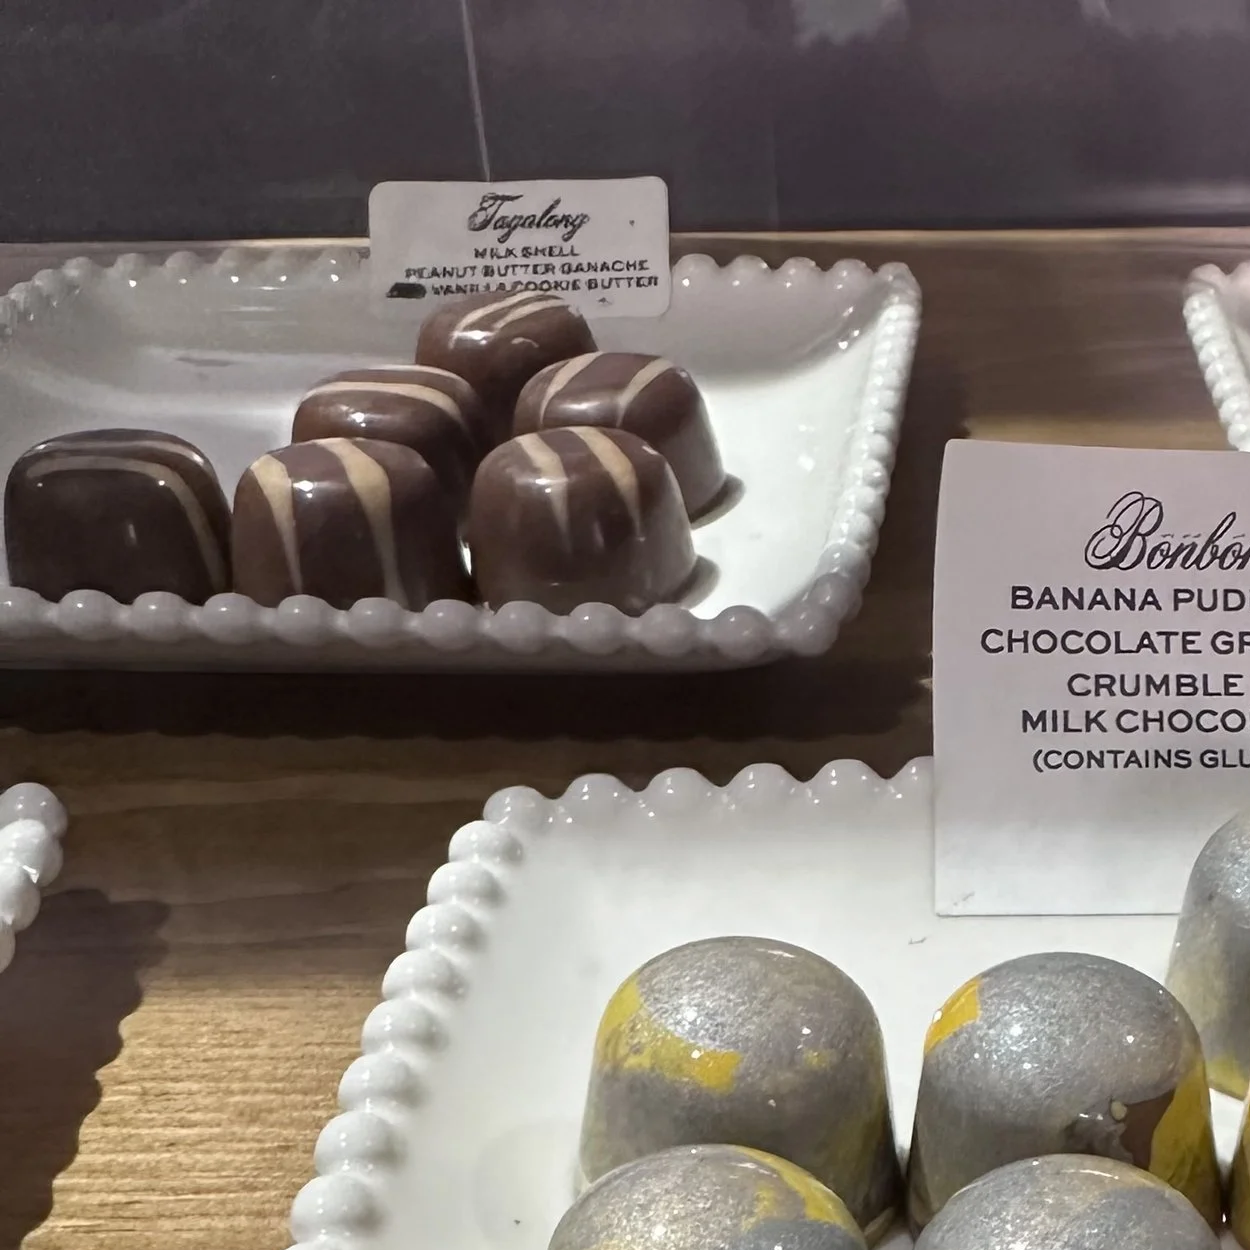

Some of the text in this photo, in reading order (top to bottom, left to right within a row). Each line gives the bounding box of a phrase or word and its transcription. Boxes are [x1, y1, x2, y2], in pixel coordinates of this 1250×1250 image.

[468, 193, 591, 243] Tagalong
[474, 245, 579, 258] MILK SHELL
[406, 260, 649, 278] PEANUT BUTTER GANACHE
[588, 276, 659, 290] BUTTER
[1011, 586, 1160, 611] BANANA
[981, 629, 1201, 654] CHOCOLATE
[1068, 674, 1243, 696] CRUMBLE
[1022, 710, 1108, 733] MILK
[1032, 749, 1192, 772] (CONTAINS
